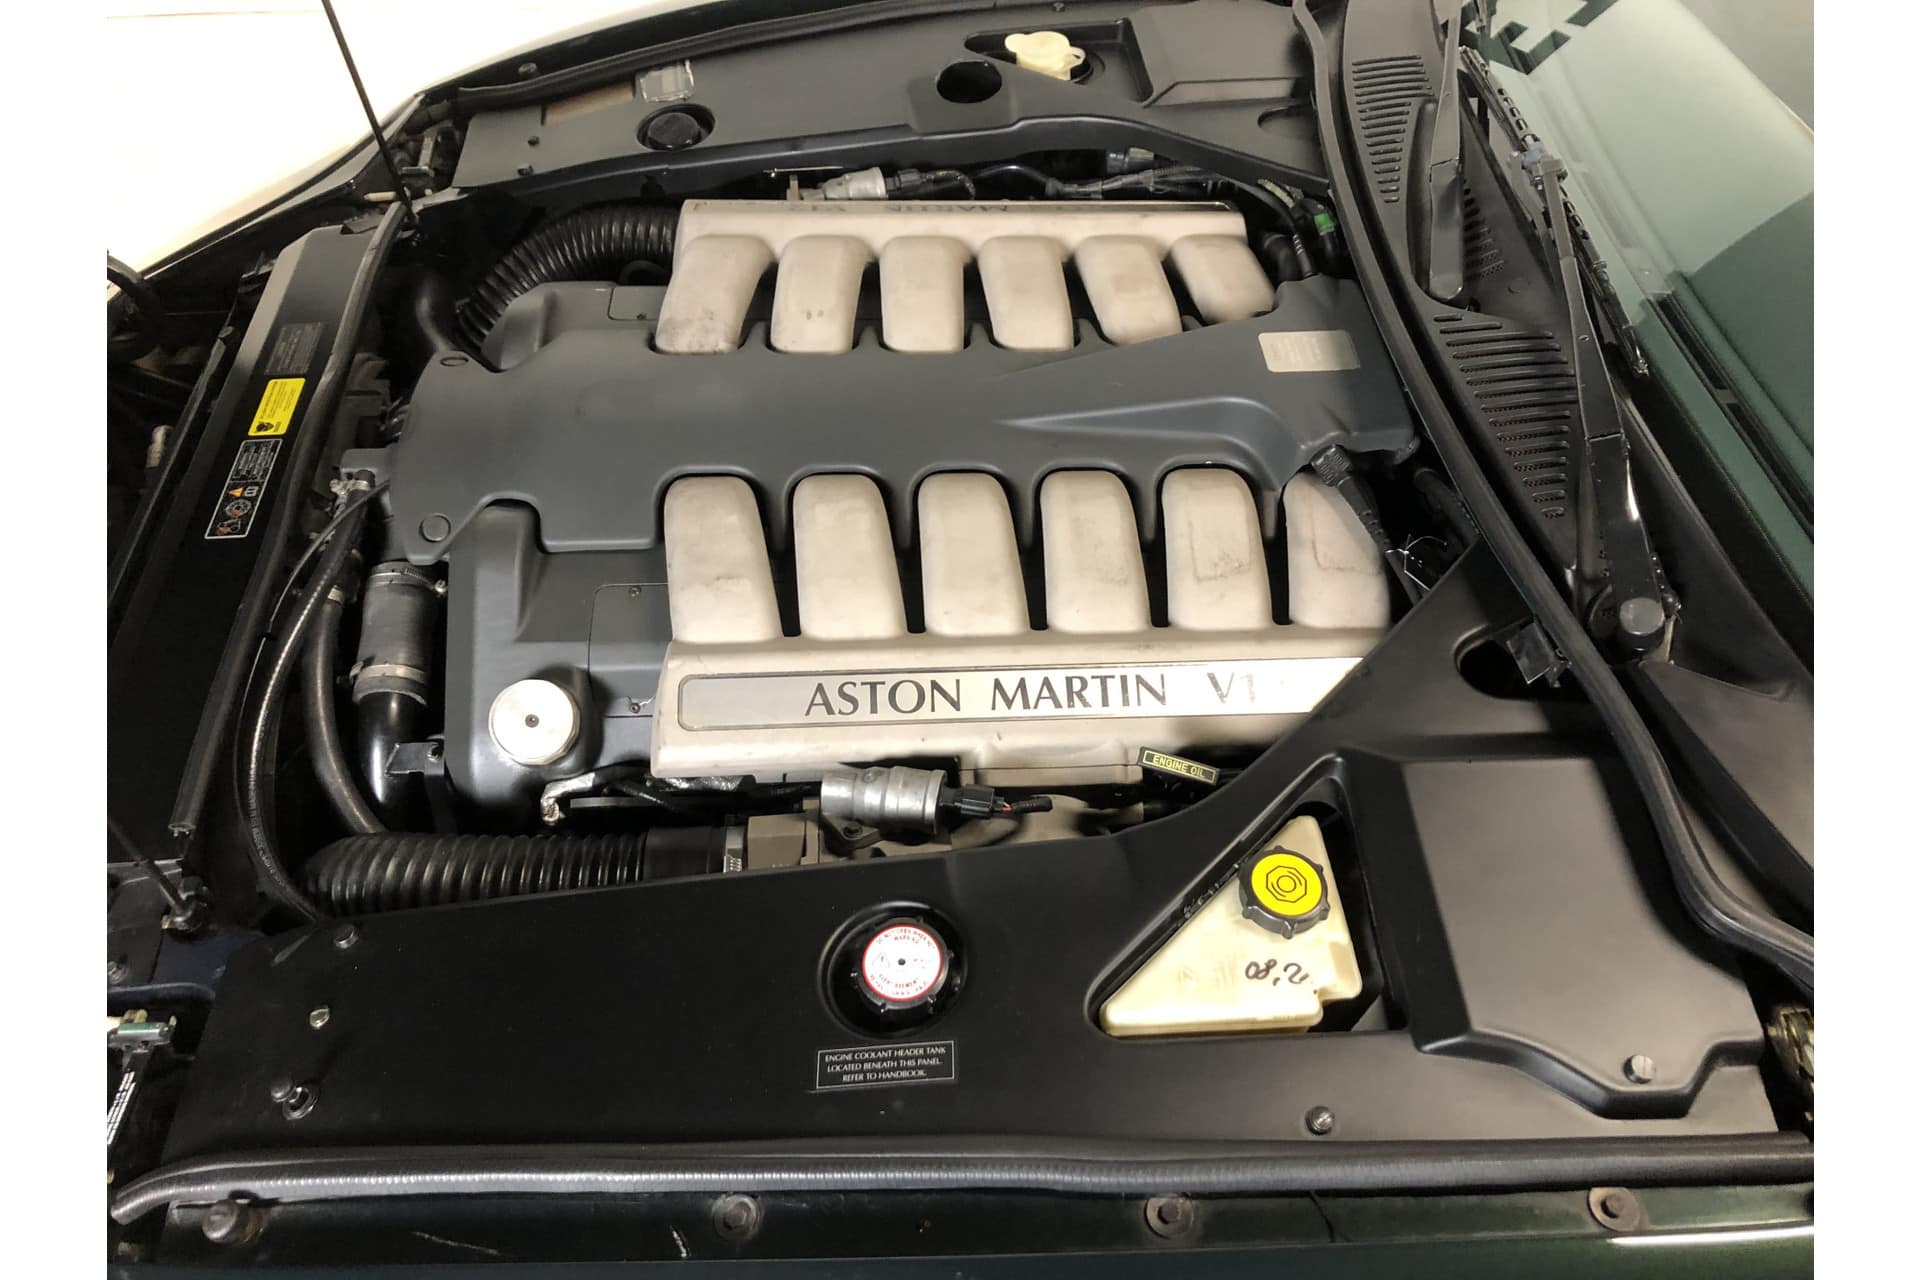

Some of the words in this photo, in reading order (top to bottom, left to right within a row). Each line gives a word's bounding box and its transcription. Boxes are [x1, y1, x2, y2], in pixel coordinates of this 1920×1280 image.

[805, 678, 962, 718] ASTON
[991, 672, 1168, 712] MARTIN
[1206, 671, 1284, 705] V1
[1152, 754, 1189, 773] ENGINE
[1190, 766, 1206, 778] OIL
[824, 1052, 853, 1063] ENGINE
[854, 1049, 893, 1060] COOLANT
[894, 1047, 925, 1058] HEADER
[926, 1046, 947, 1055] TANK
[827, 1062, 862, 1073] LOCATED
[863, 1060, 898, 1071] BENEATH
[899, 1058, 916, 1068] THIS
[842, 1072, 865, 1082] REFER
[866, 1071, 877, 1080] TO
